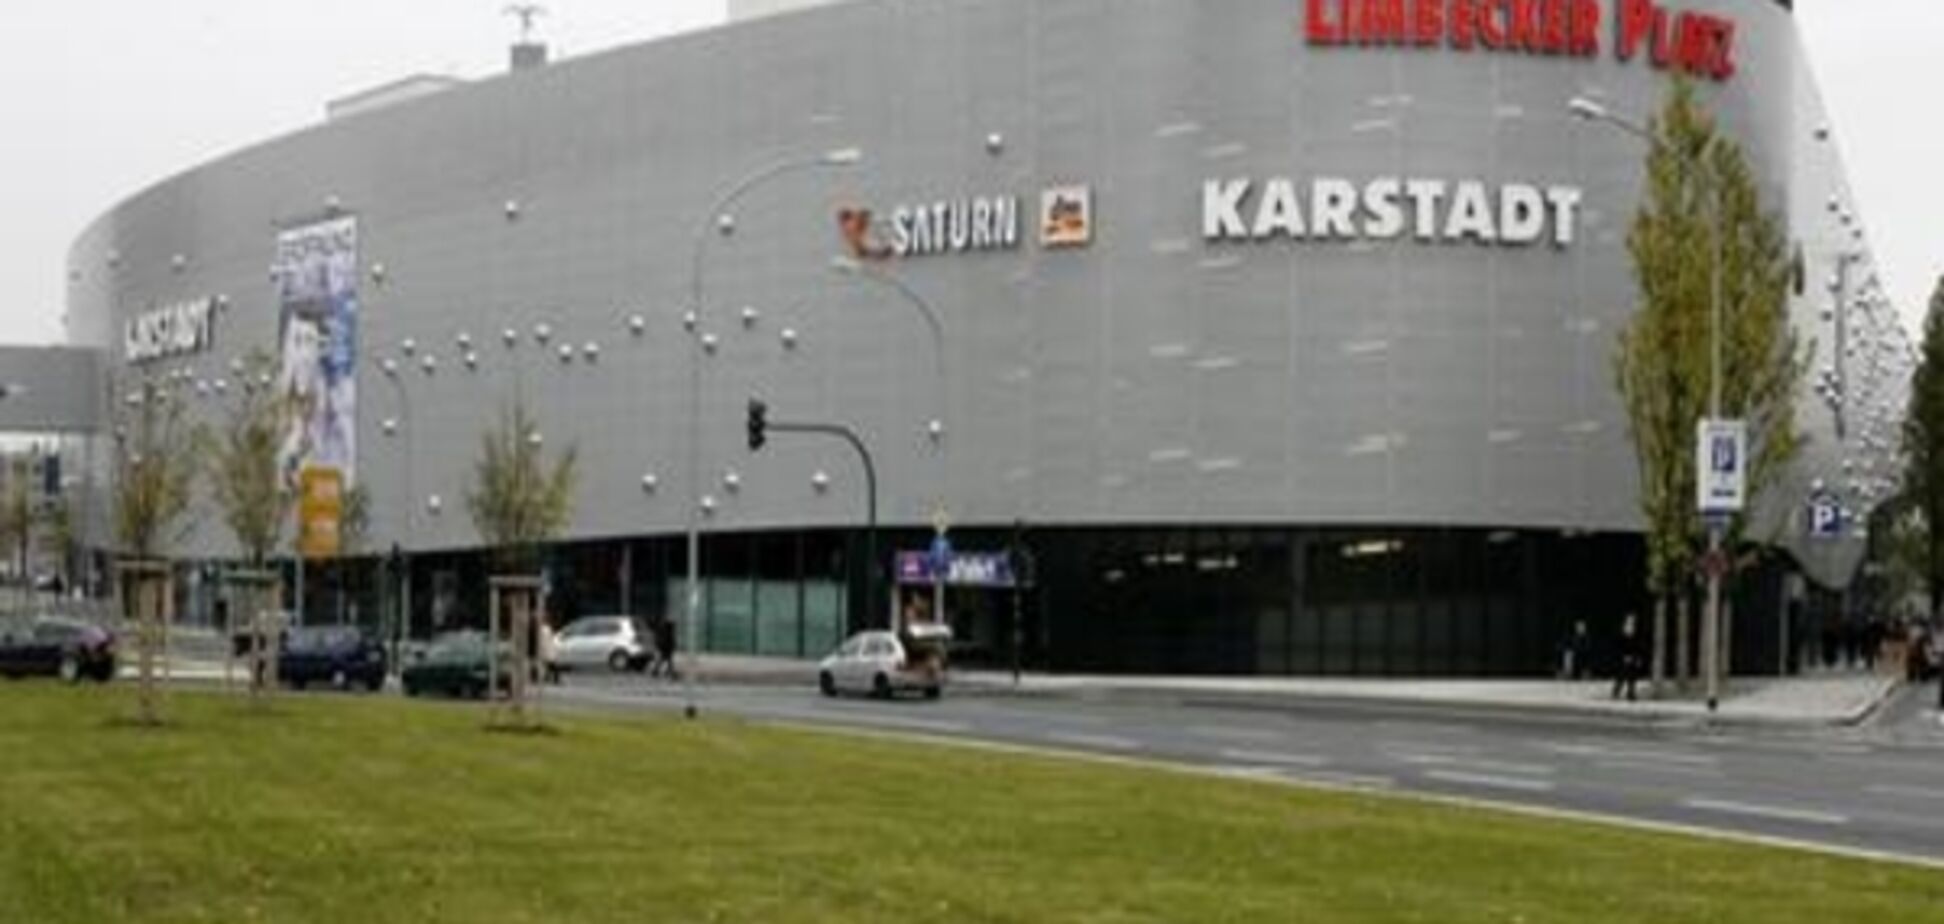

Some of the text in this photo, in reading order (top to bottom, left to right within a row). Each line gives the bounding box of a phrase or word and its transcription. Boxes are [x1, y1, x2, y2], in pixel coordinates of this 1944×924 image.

[892, 196, 1017, 253] SATURN
[1204, 175, 1582, 243] KARSTADT
[1813, 506, 1834, 534] P
